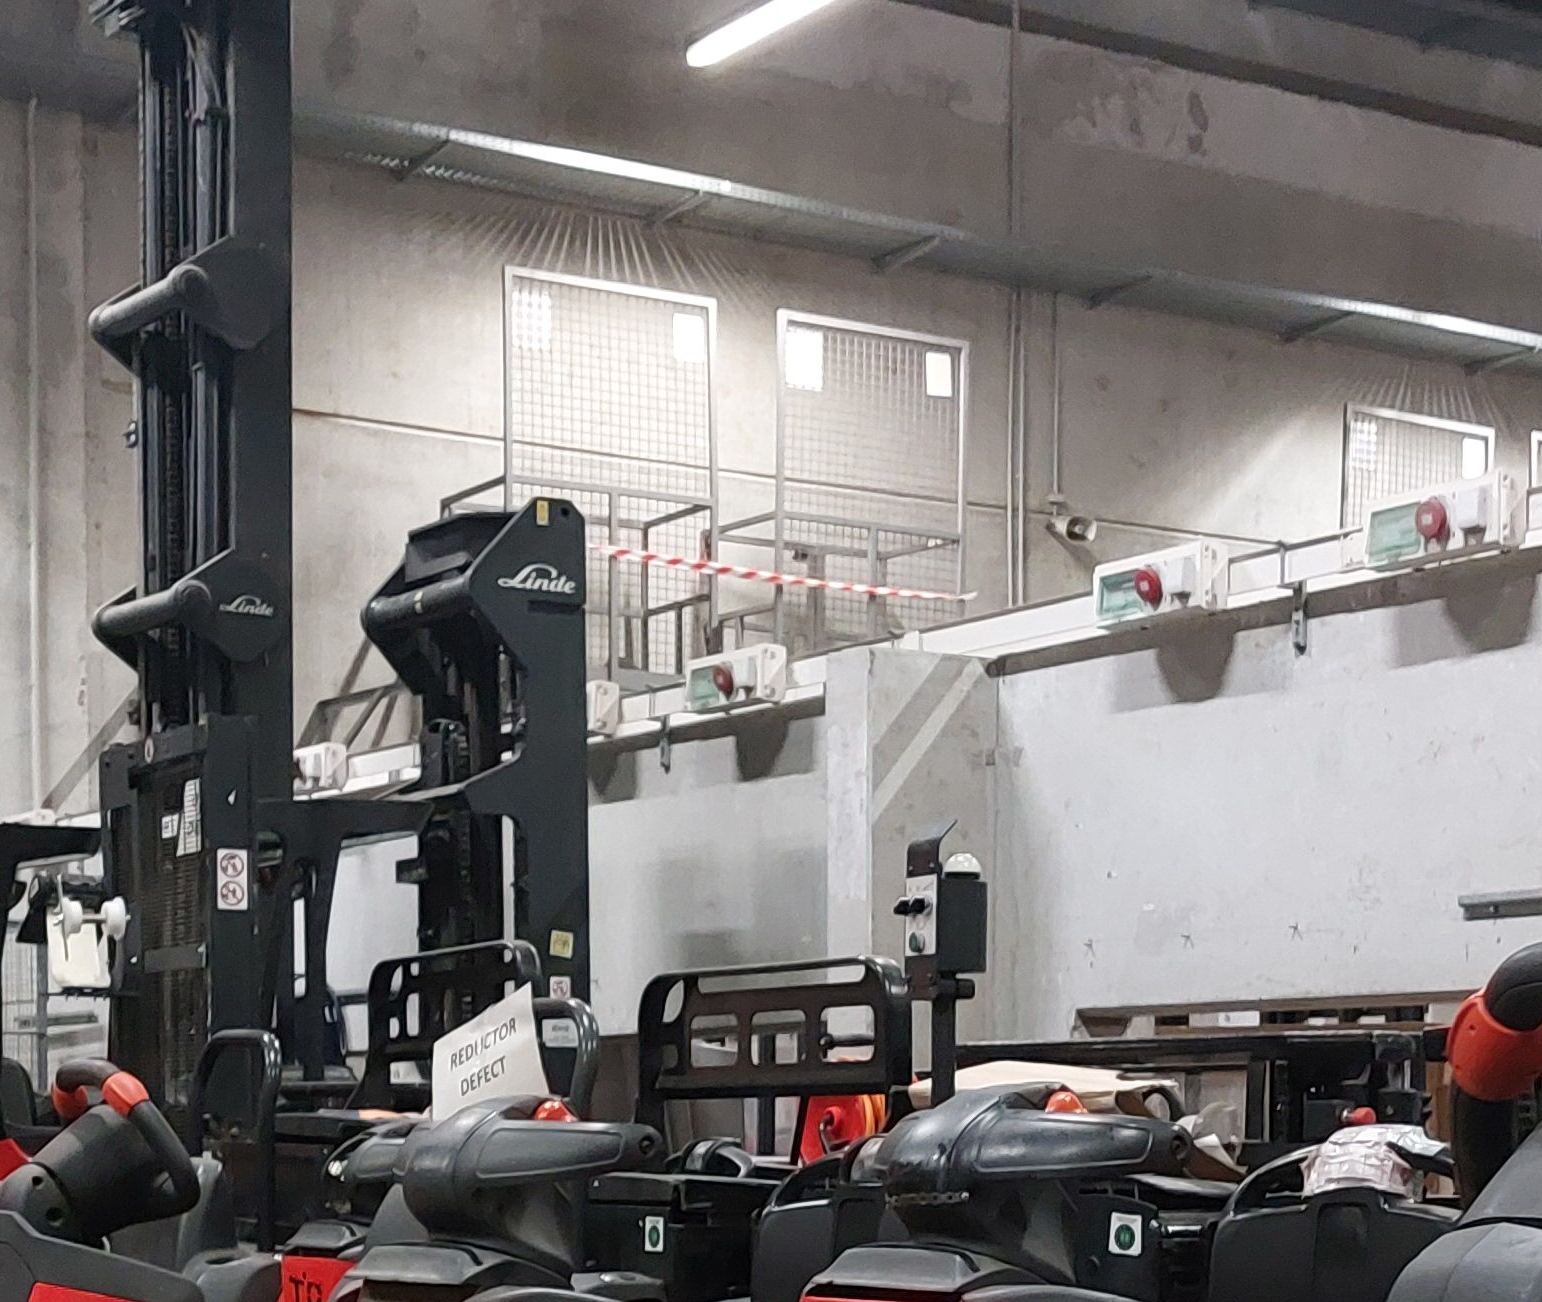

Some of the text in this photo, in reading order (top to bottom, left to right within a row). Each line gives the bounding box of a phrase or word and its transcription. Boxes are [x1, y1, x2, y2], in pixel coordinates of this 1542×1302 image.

[497, 563, 577, 594] Linde
[219, 594, 274, 616] Linde
[450, 1016, 517, 1071] REDUCTOR
[461, 1055, 507, 1096] DEFECT
